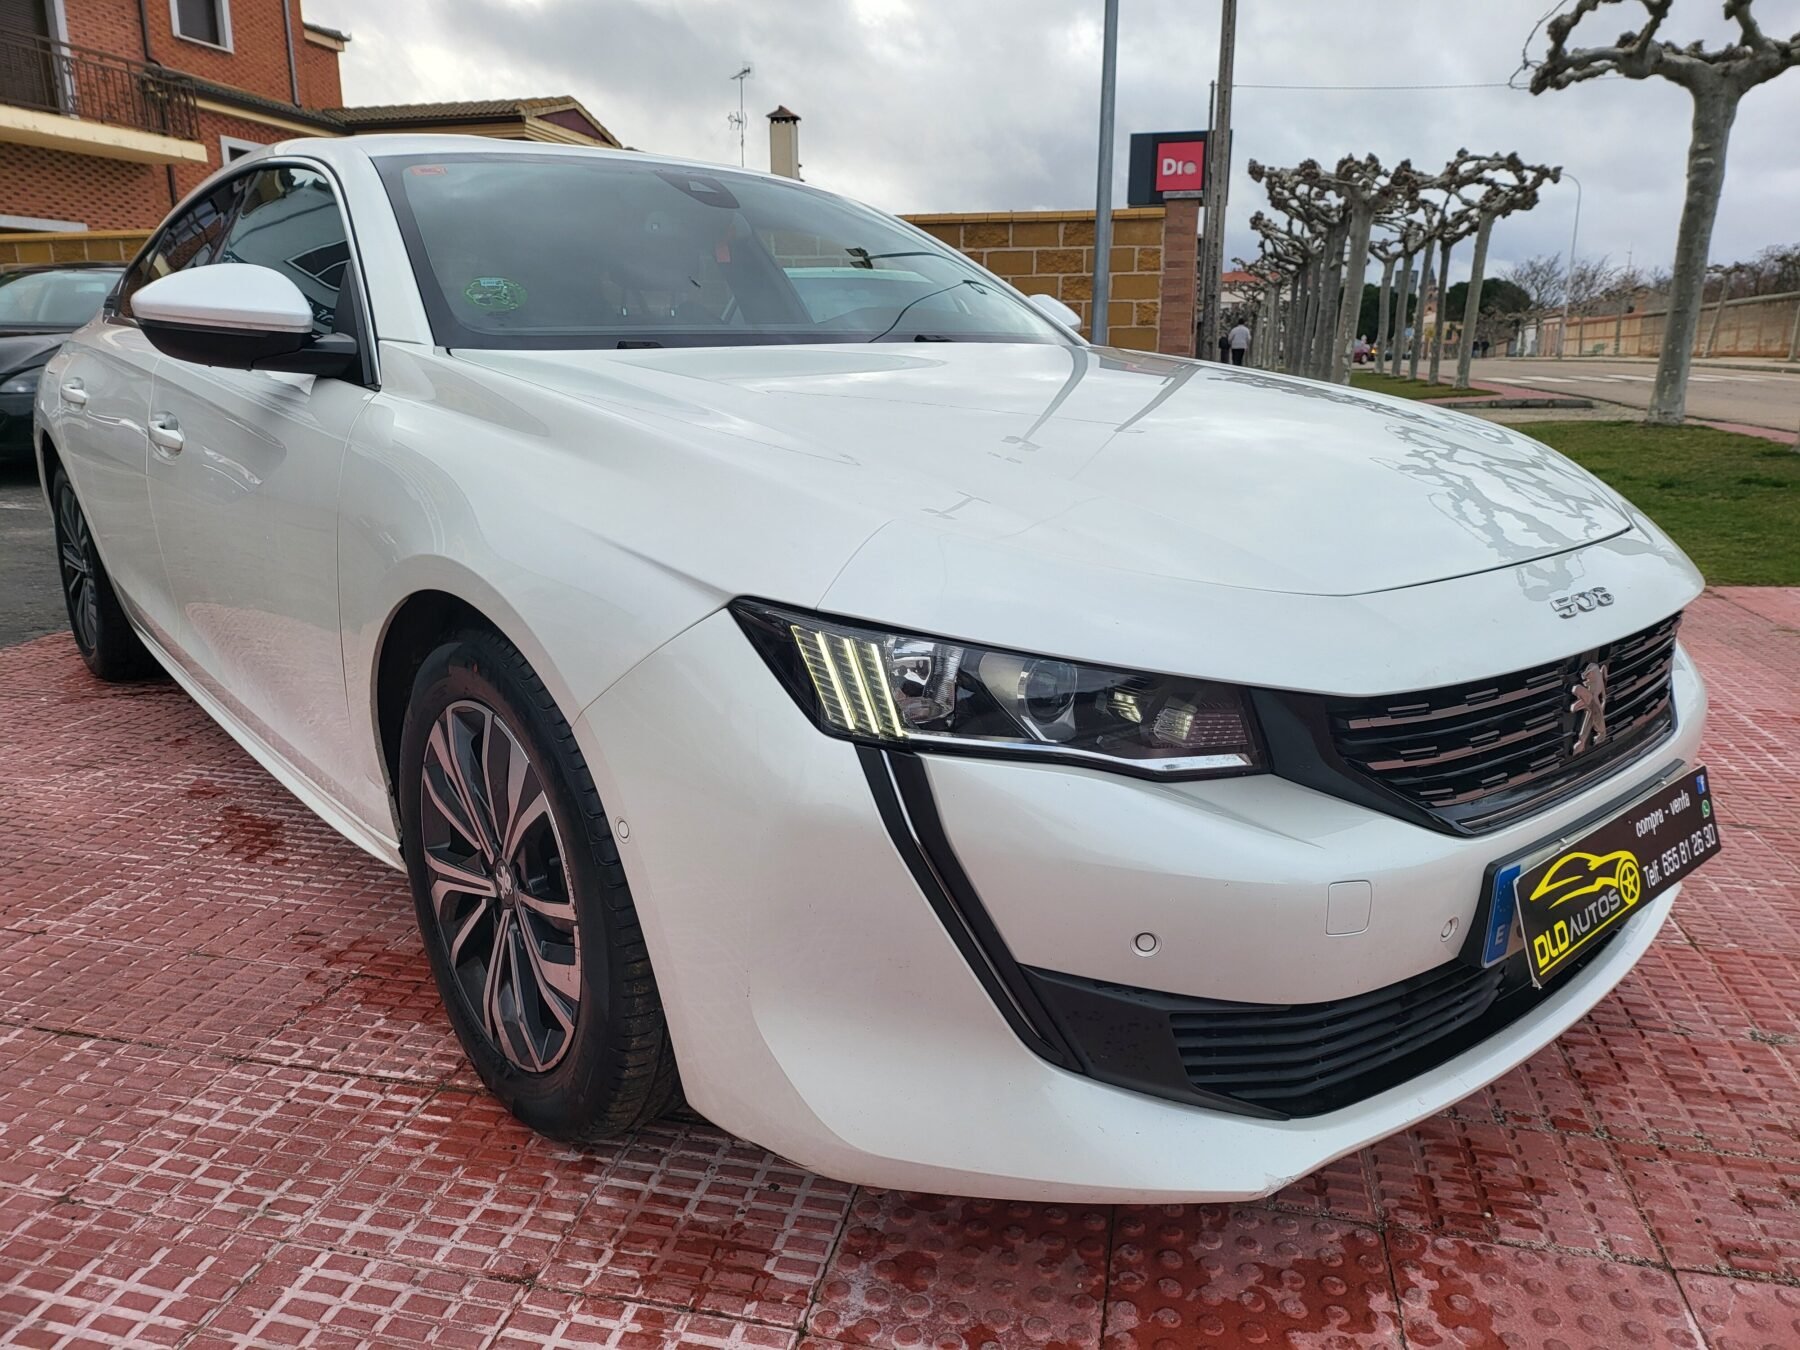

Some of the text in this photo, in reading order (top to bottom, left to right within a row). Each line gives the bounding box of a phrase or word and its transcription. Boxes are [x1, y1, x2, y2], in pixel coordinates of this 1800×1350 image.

[1635, 808, 1665, 838] compra
[1669, 789, 1691, 816] venta
[1642, 823, 1717, 888] Telf. 655 81 26 30
[1495, 924, 1506, 946] E
